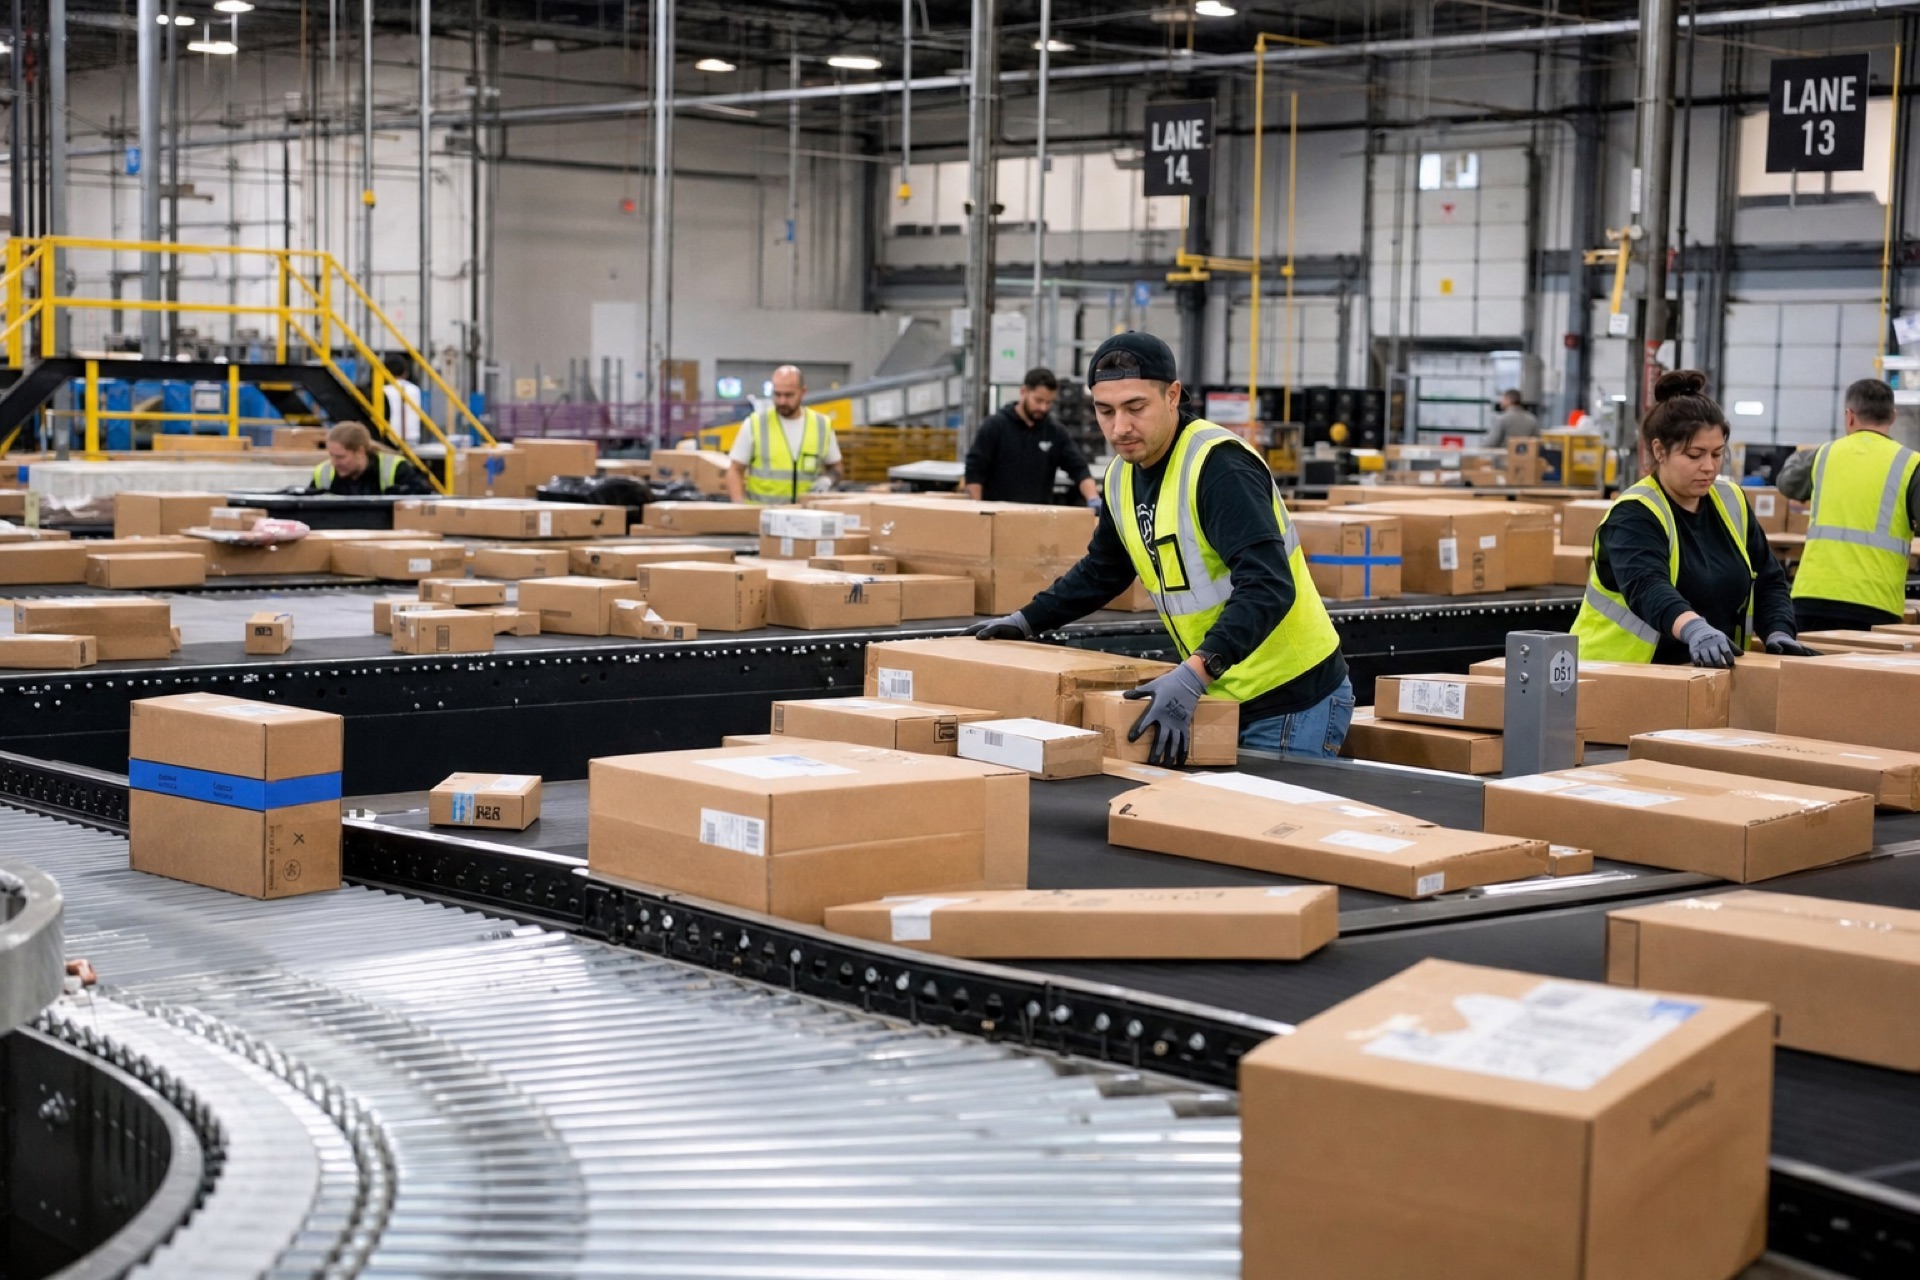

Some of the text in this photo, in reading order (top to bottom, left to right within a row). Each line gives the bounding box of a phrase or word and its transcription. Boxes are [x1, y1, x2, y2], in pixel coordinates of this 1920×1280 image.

[1782, 75, 1857, 115] LANE
[1151, 119, 1205, 151] LANE
[1801, 119, 1836, 156] 13
[1164, 154, 1193, 185] 14
[1554, 666, 1571, 682] D51
